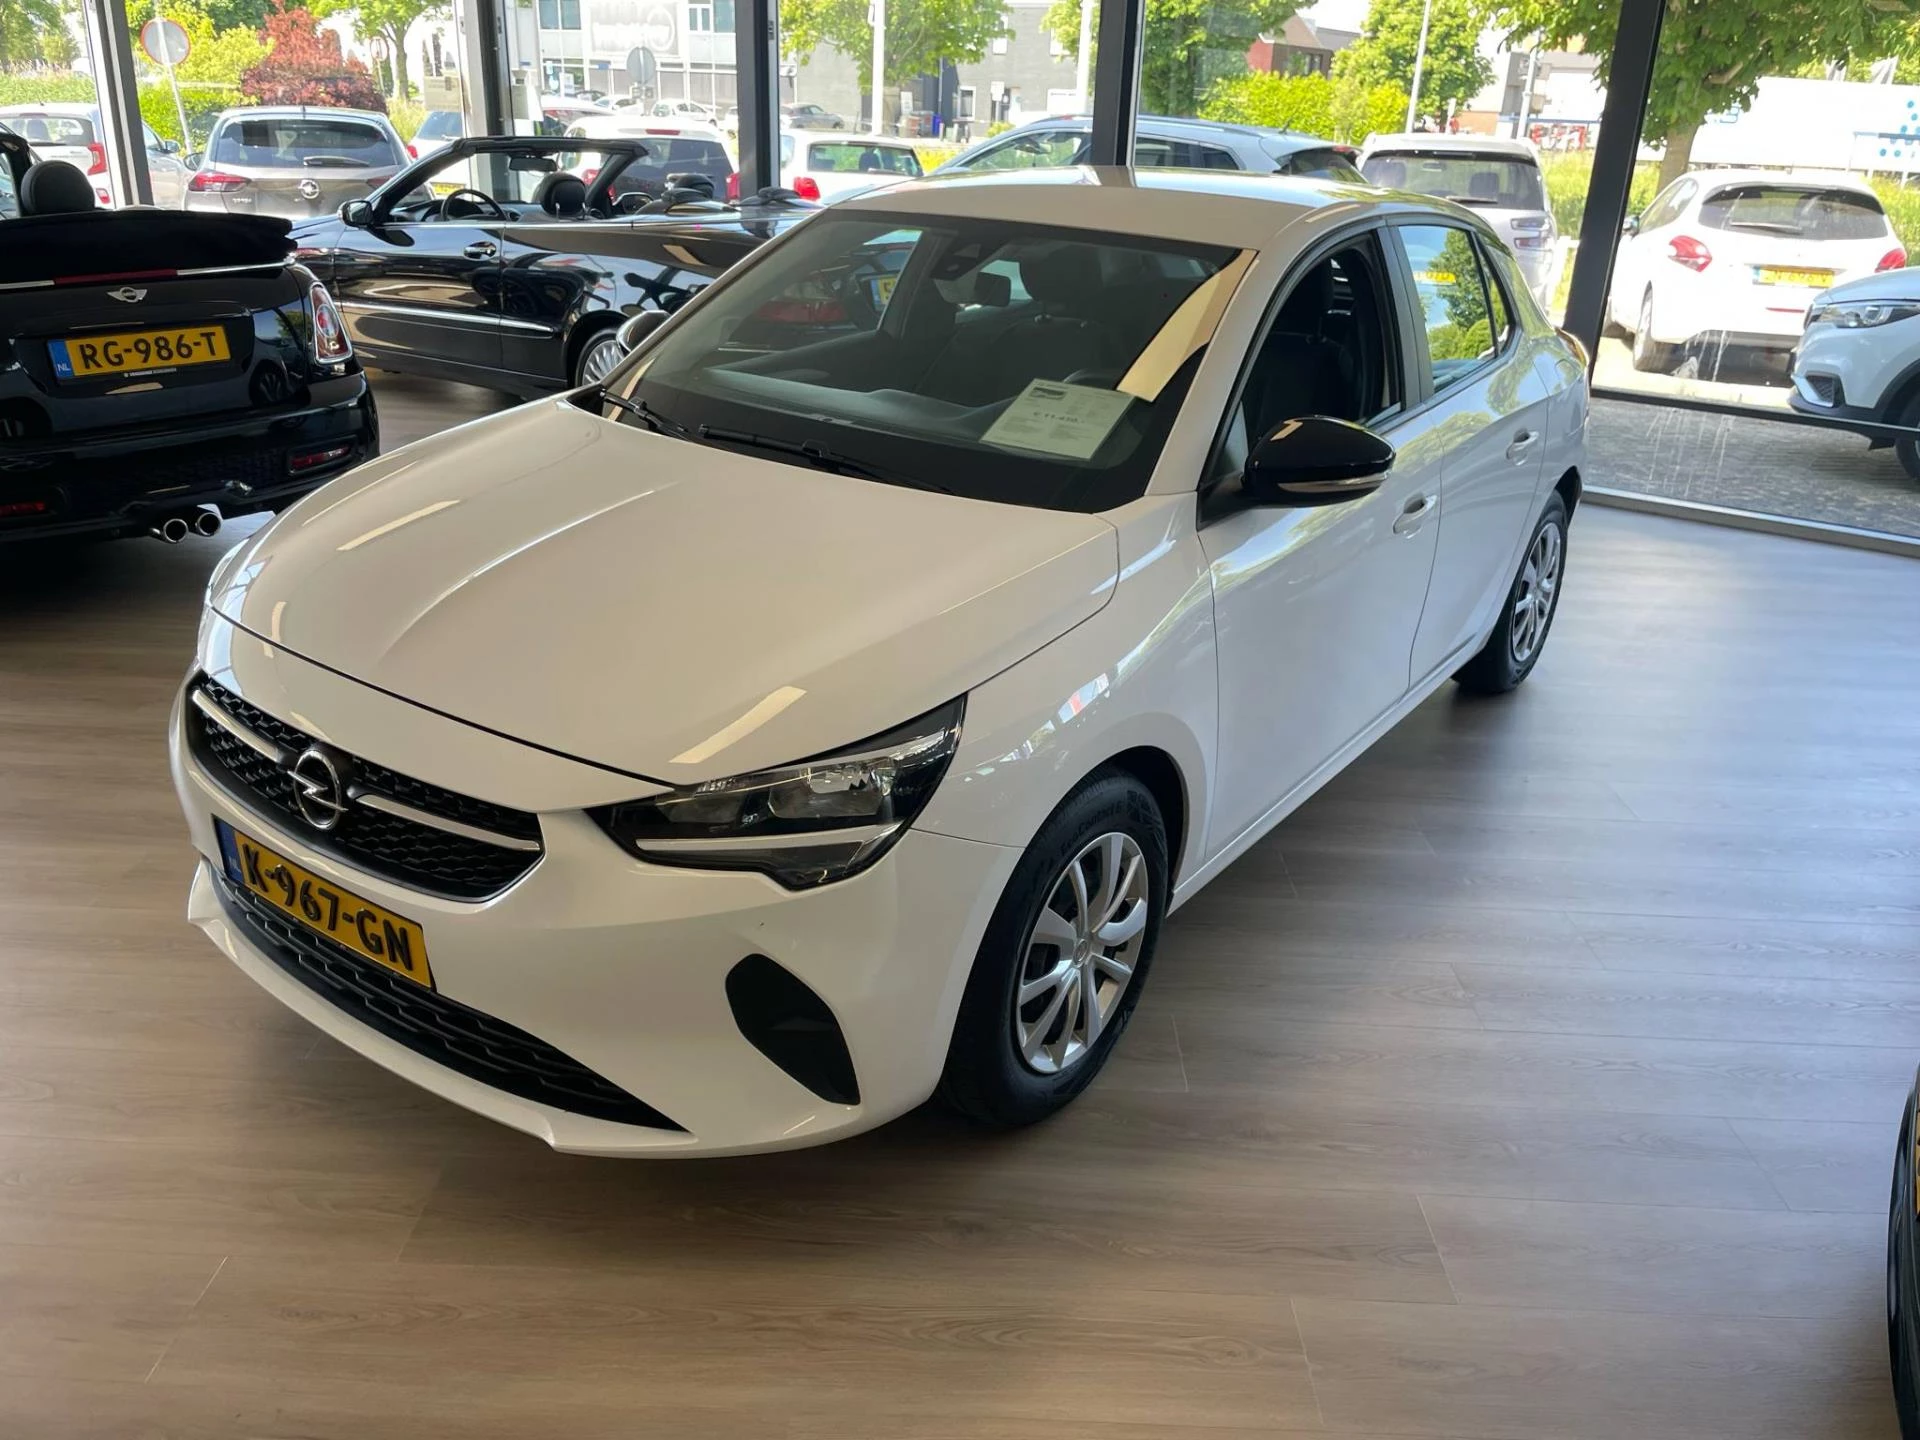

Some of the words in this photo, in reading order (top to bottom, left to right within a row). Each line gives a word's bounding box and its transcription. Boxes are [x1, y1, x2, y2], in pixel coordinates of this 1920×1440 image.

[57, 363, 70, 371] NL
[78, 331, 216, 369] RG-986-T
[243, 843, 413, 971] K-967-GN
